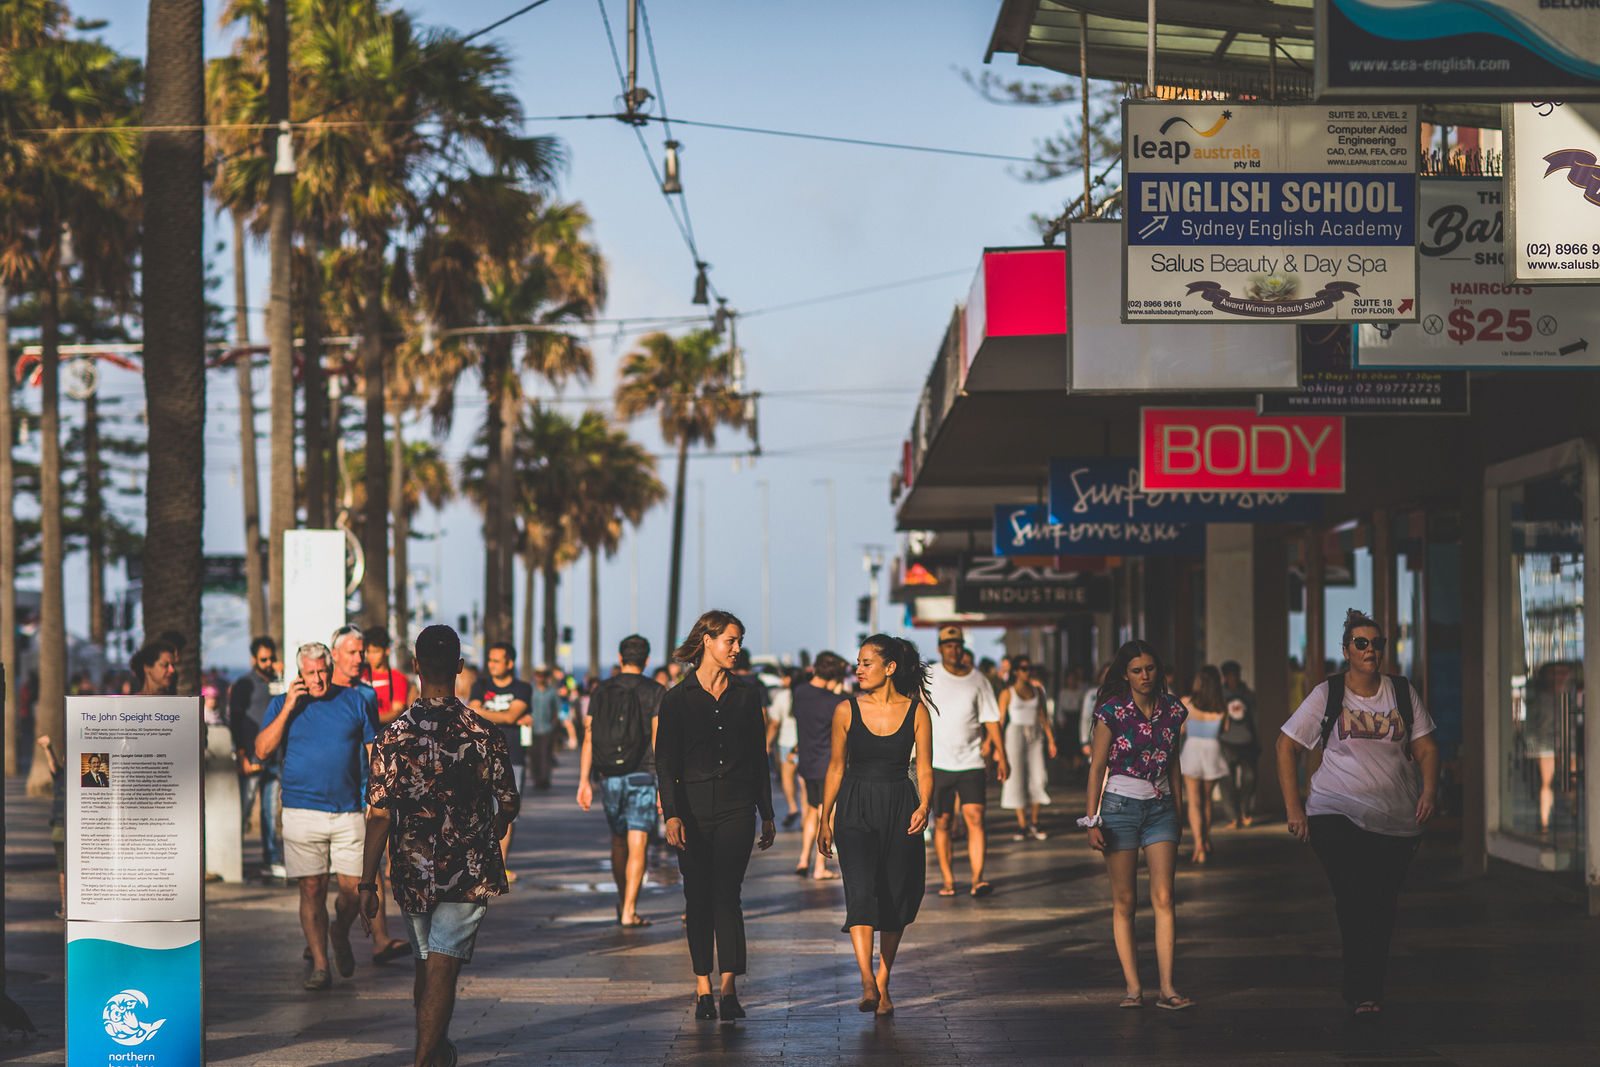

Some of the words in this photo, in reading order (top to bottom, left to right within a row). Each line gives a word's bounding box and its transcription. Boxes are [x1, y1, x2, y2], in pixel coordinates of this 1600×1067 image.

[1538, 0, 1600, 9] BELON
[1348, 56, 1510, 74] www.sea-english.com
[1328, 110, 1354, 119] SUITE
[1356, 110, 1370, 120] 20,
[1372, 110, 1398, 119] LEVEL
[1401, 110, 1408, 119] 2
[1327, 125, 1376, 137] Computer
[1378, 124, 1408, 135] Aided
[1338, 135, 1396, 147] Engineering
[1133, 134, 1191, 165] leap
[1193, 144, 1260, 160] australia
[1327, 148, 1345, 156] CAD,
[1346, 148, 1368, 156] CAM,
[1370, 148, 1388, 156] FEA,
[1390, 148, 1408, 156] CFD
[1234, 160, 1248, 170] pty
[1249, 160, 1260, 168] ltd
[1140, 181, 1270, 213] ENGLISH
[1281, 181, 1402, 213] SCHOOL
[1478, 192, 1503, 204] TH
[1181, 219, 1244, 240] Sydney
[1250, 219, 1314, 240] English
[1320, 219, 1402, 240] Academy
[1420, 204, 1504, 256] Bar
[1526, 244, 1552, 258] (02)
[1555, 244, 1588, 256] 8966
[1151, 253, 1204, 273] Salus
[1210, 253, 1278, 277] Beauty
[1283, 254, 1298, 273] &
[1304, 253, 1342, 276] Day
[1346, 253, 1387, 276] Spa
[1527, 259, 1600, 271] www.salusb
[1450, 282, 1533, 296] HAIRCUTS
[1128, 300, 1142, 308] (02)
[1144, 300, 1162, 308] 8966
[1163, 300, 1182, 308] 9616
[1220, 298, 1244, 311] Award
[1245, 302, 1276, 314] Winning
[1276, 302, 1303, 314] Beauty
[1304, 298, 1326, 310] Salon
[1354, 298, 1380, 307] SUITE
[1382, 298, 1392, 307] 18
[1454, 298, 1472, 306] from
[1128, 308, 1214, 316] www.salusbeautymanly.com
[1351, 308, 1368, 316] (TOP
[1369, 308, 1395, 316] FLOOR)
[1447, 306, 1533, 345] $25
[1356, 384, 1371, 393] 02
[1376, 384, 1441, 393] 99772725
[1161, 424, 1332, 476] BODY
[980, 586, 1086, 604] INDUSTRIE
[80, 712, 96, 721] The
[98, 712, 118, 723] John
[120, 712, 153, 723] Speight
[154, 712, 180, 723] Stage
[108, 1052, 155, 1061] northern
